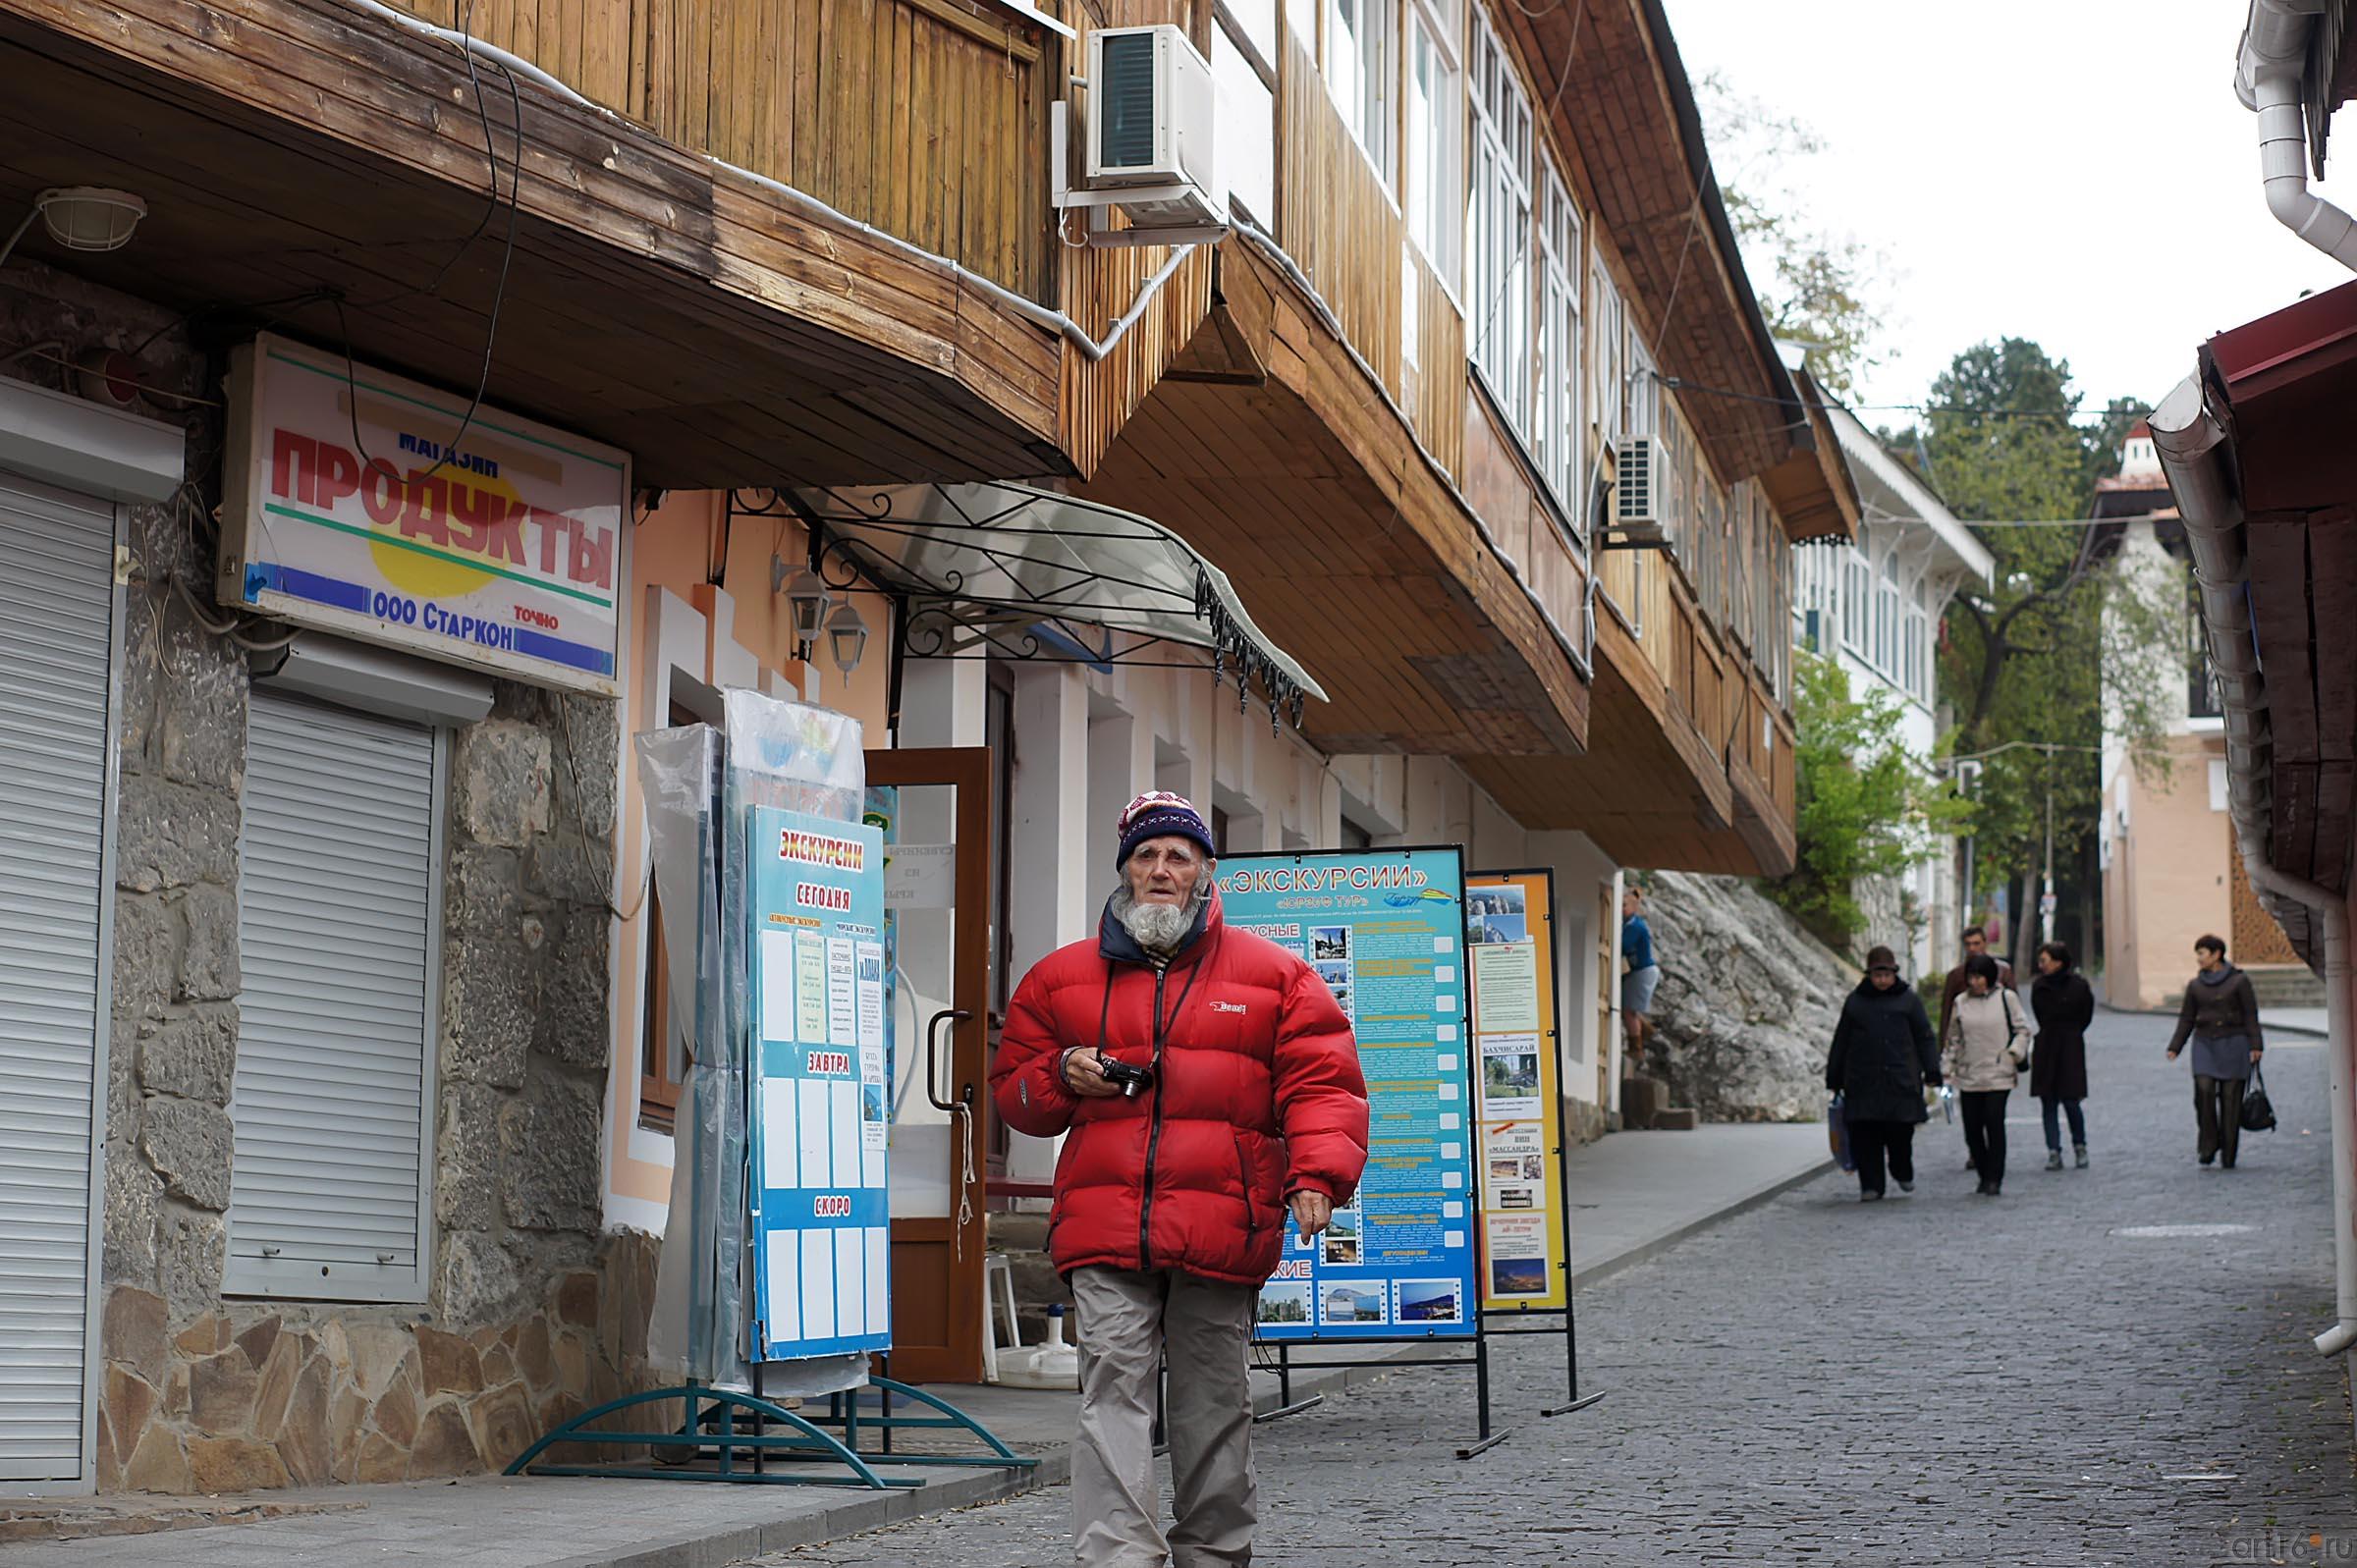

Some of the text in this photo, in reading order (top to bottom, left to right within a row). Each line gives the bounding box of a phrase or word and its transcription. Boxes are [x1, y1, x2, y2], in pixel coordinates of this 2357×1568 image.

[271, 427, 614, 591] ПРОДУКТЫ
[373, 592, 416, 624] ООО
[514, 604, 559, 630] ТОЧНО
[780, 829, 863, 871] ЭКСКУРСИИ
[1219, 864, 1428, 893] «ЭКСКУРСИИ»
[796, 884, 850, 911] СЕГОДНЯ
[1241, 924, 1299, 938] УСНЫЕ
[1483, 1044, 1535, 1054] БАХЧИСАРАЙ
[807, 1052, 850, 1074] ЗАВТРА
[815, 1196, 850, 1217] СКОРО
[1277, 1261, 1312, 1278] КИЕ
